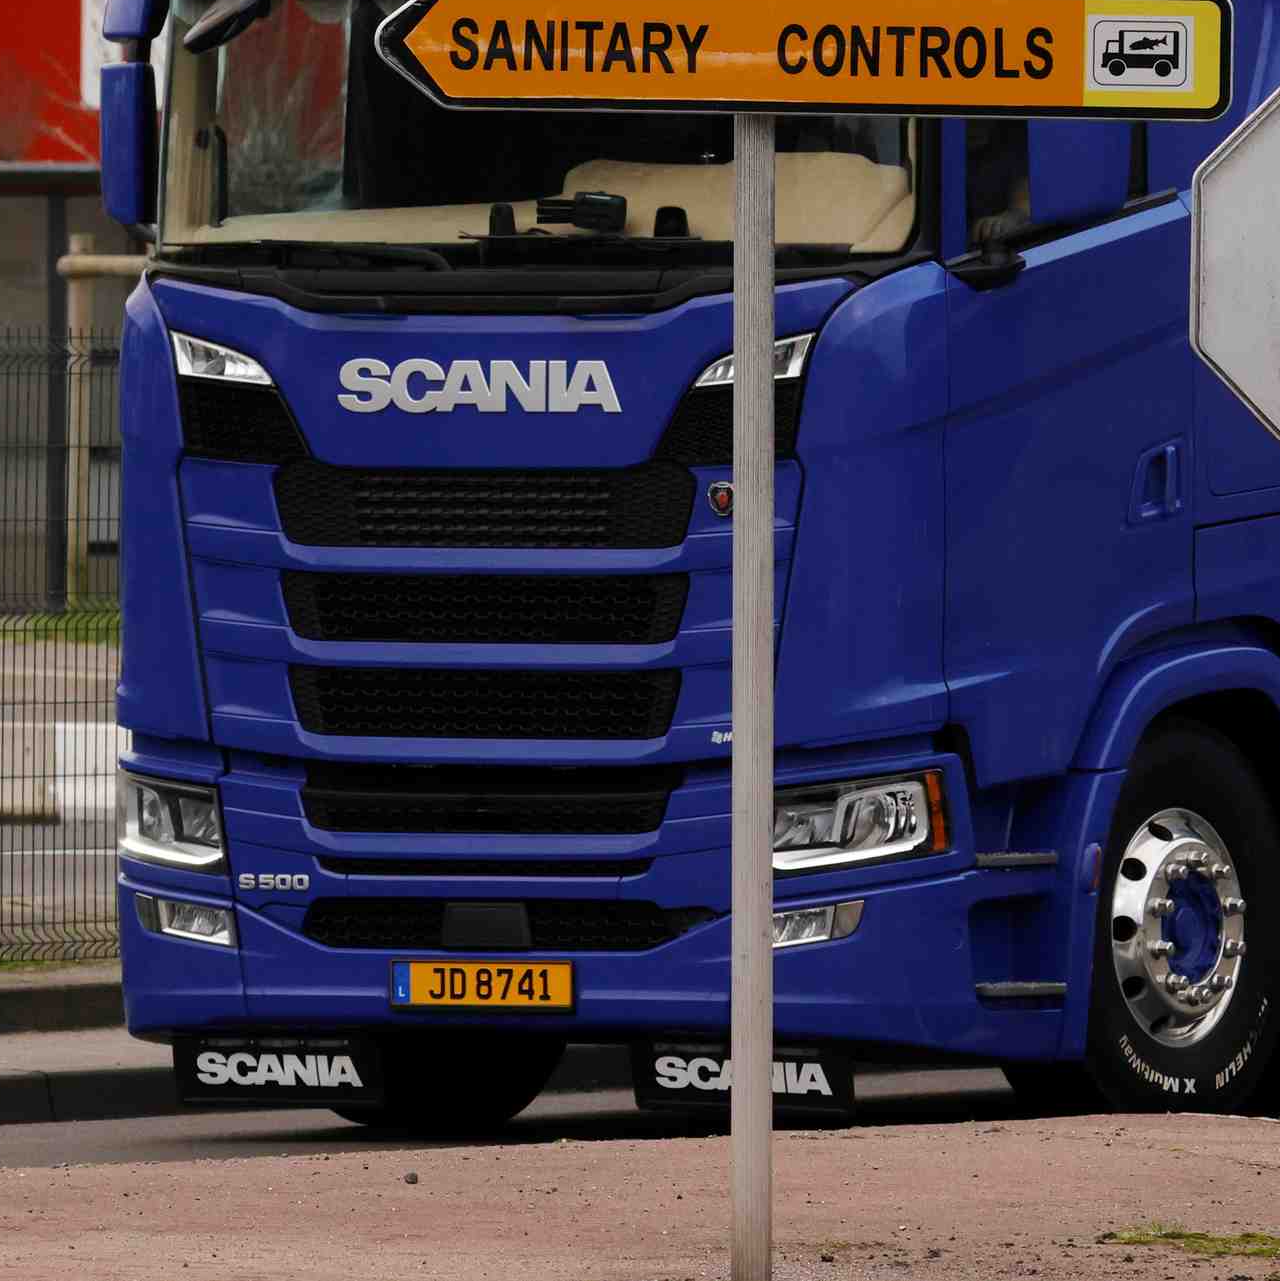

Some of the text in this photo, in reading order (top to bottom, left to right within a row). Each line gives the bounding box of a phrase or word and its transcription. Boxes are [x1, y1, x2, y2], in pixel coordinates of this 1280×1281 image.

[449, 17, 1054, 80] SANITARY CONTROLS
[337, 357, 622, 414] SCANIA
[238, 872, 311, 892] S 500
[397, 985, 407, 997] L
[429, 967, 552, 1001] JD 8741
[196, 1051, 364, 1088] SCANIA
[1119, 1035, 1180, 1094] MultiWay
